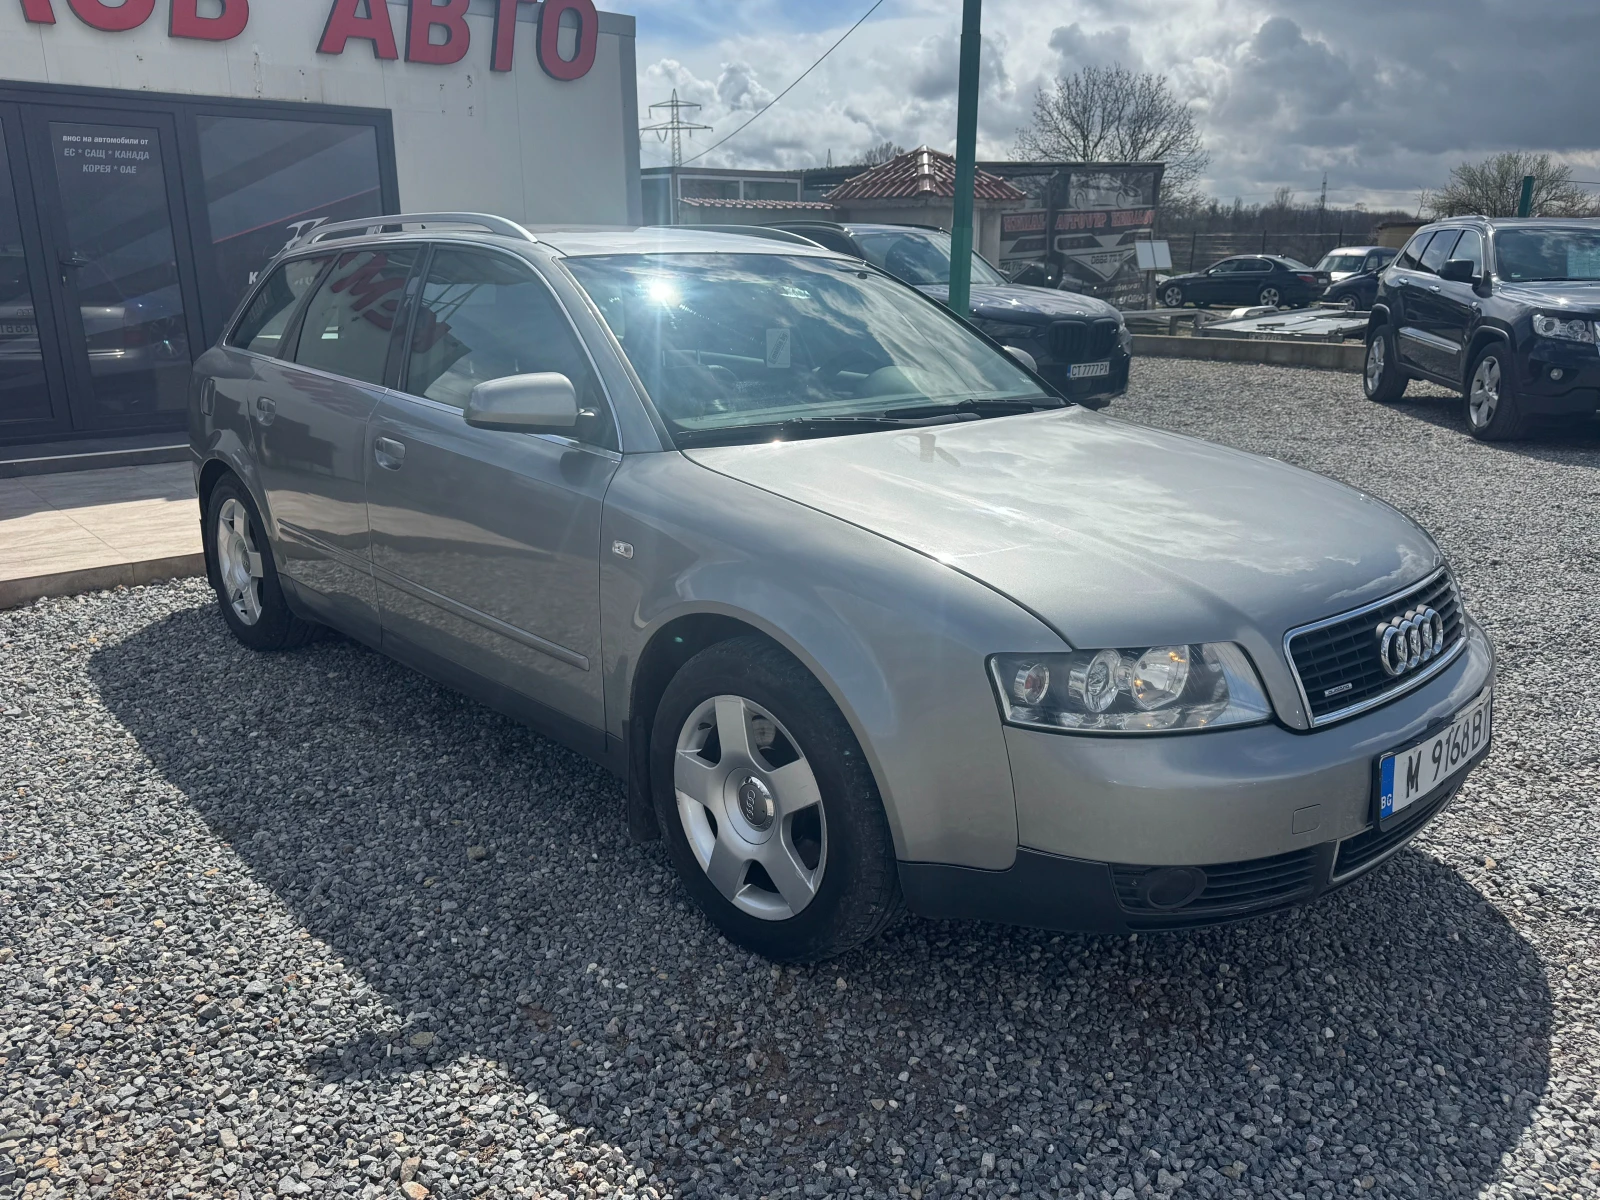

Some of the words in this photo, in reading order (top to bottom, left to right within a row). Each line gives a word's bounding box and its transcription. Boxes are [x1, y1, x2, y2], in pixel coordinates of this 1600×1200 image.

[315, 0, 599, 81] АВТО
[93, 136, 139, 144] автомобили
[64, 148, 76, 157] ЕС
[84, 148, 105, 159] САЩ
[114, 150, 150, 160] КАНАДА
[82, 164, 111, 173] КОРЕЯ
[120, 165, 137, 174] ОАЕ
[1405, 750, 1422, 799] M
[1381, 793, 1392, 810] BG
